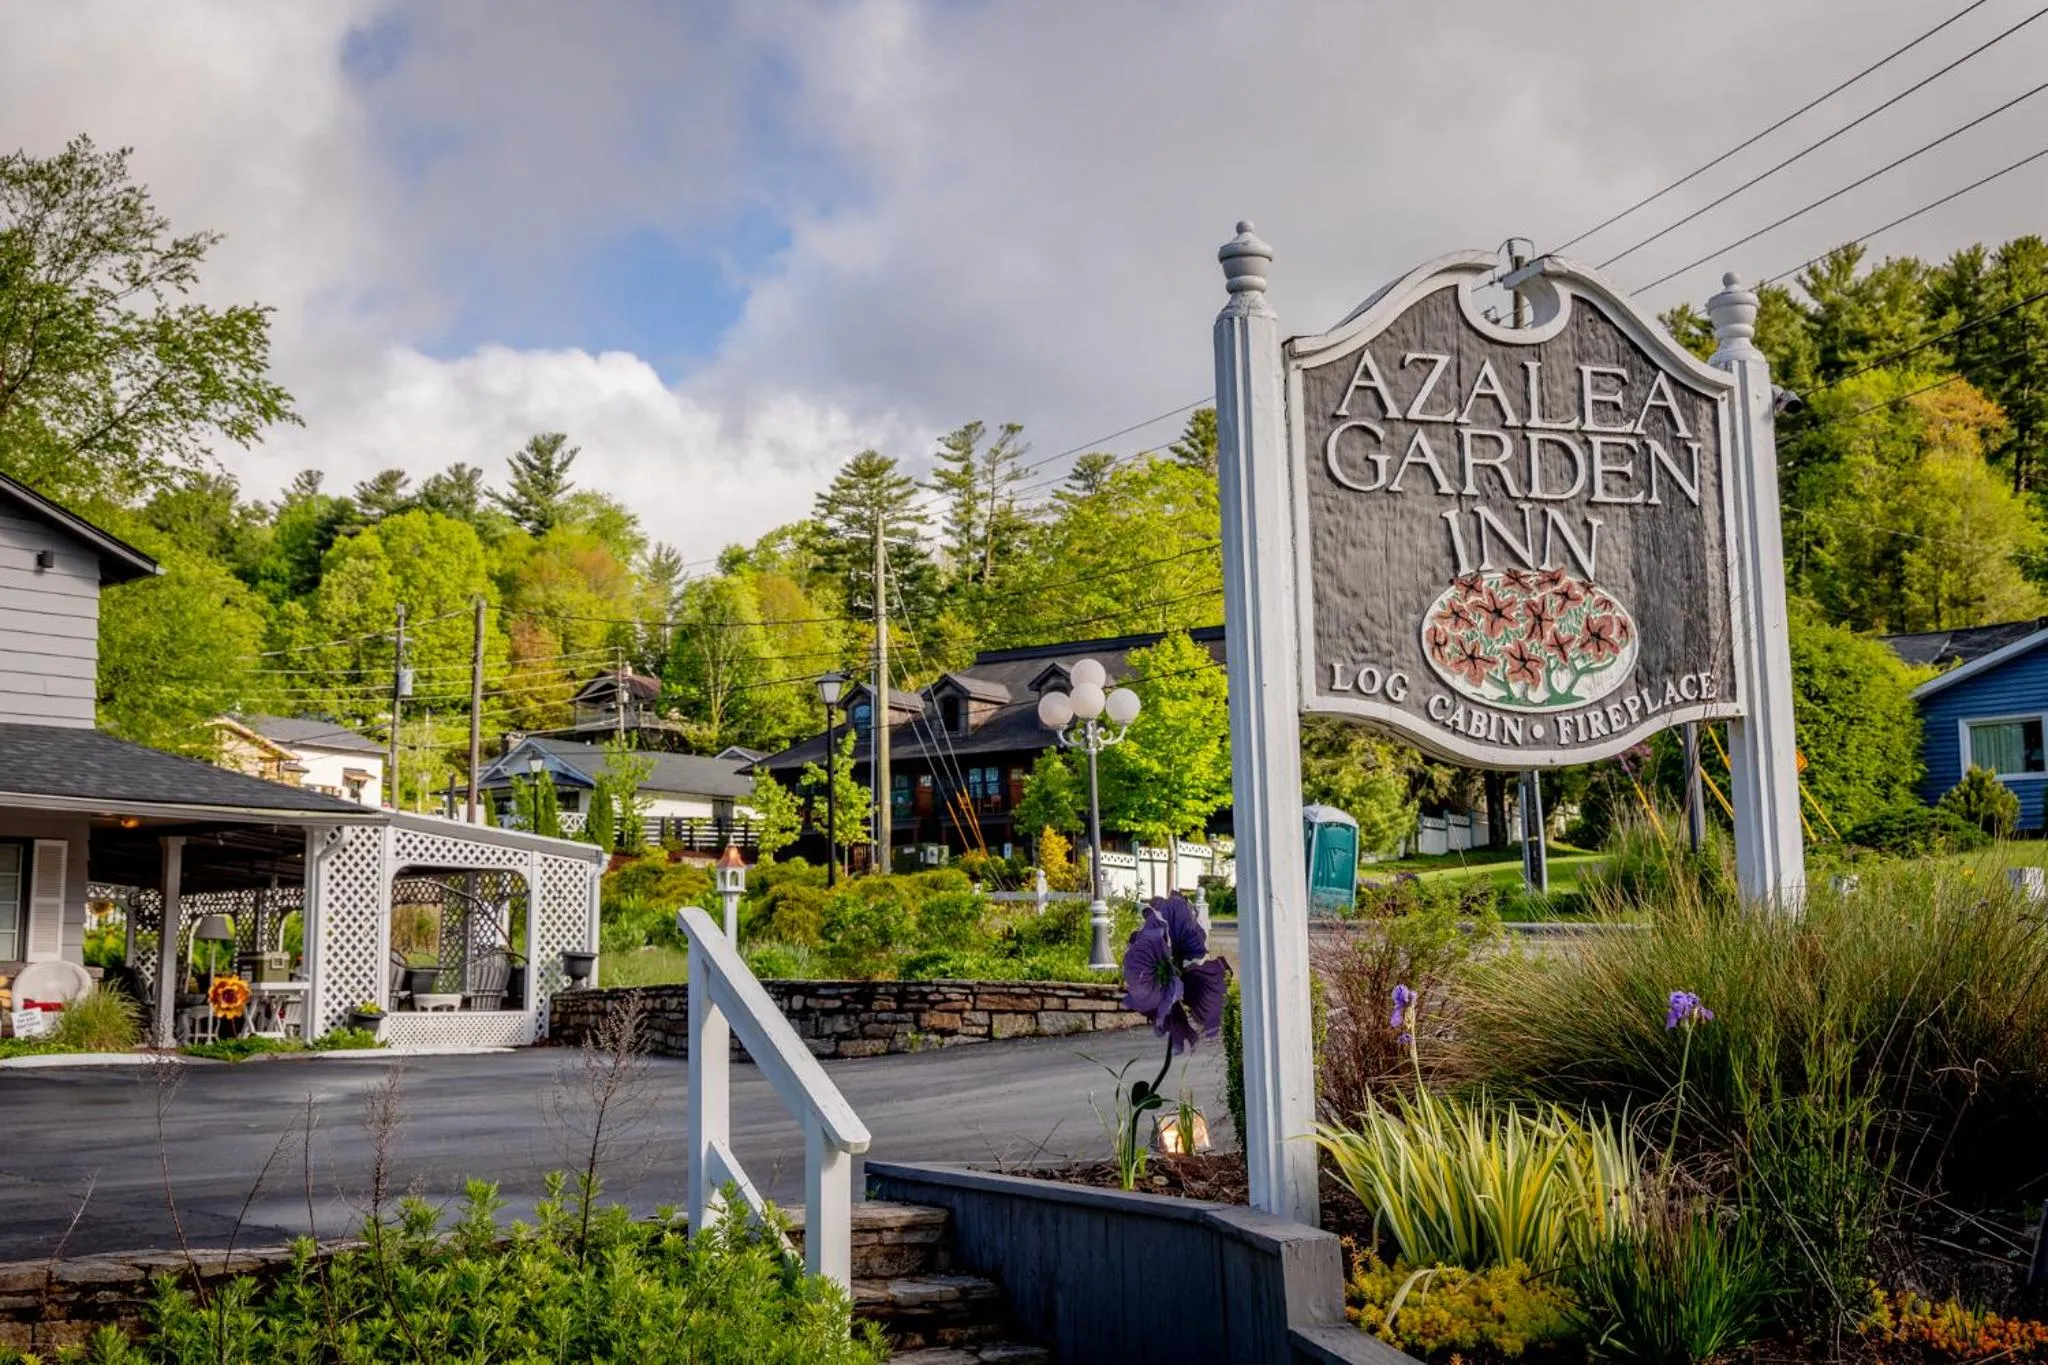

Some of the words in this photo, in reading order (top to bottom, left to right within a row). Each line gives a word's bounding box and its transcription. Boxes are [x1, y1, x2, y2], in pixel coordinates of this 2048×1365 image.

[1335, 349, 1693, 438] AZALEA
[1326, 421, 1702, 506] GARDEN
[1441, 503, 1603, 580] INN
[1331, 663, 1409, 701] LOG
[1426, 694, 1525, 745] CABIN
[1557, 671, 1718, 745] FIREPLACE
